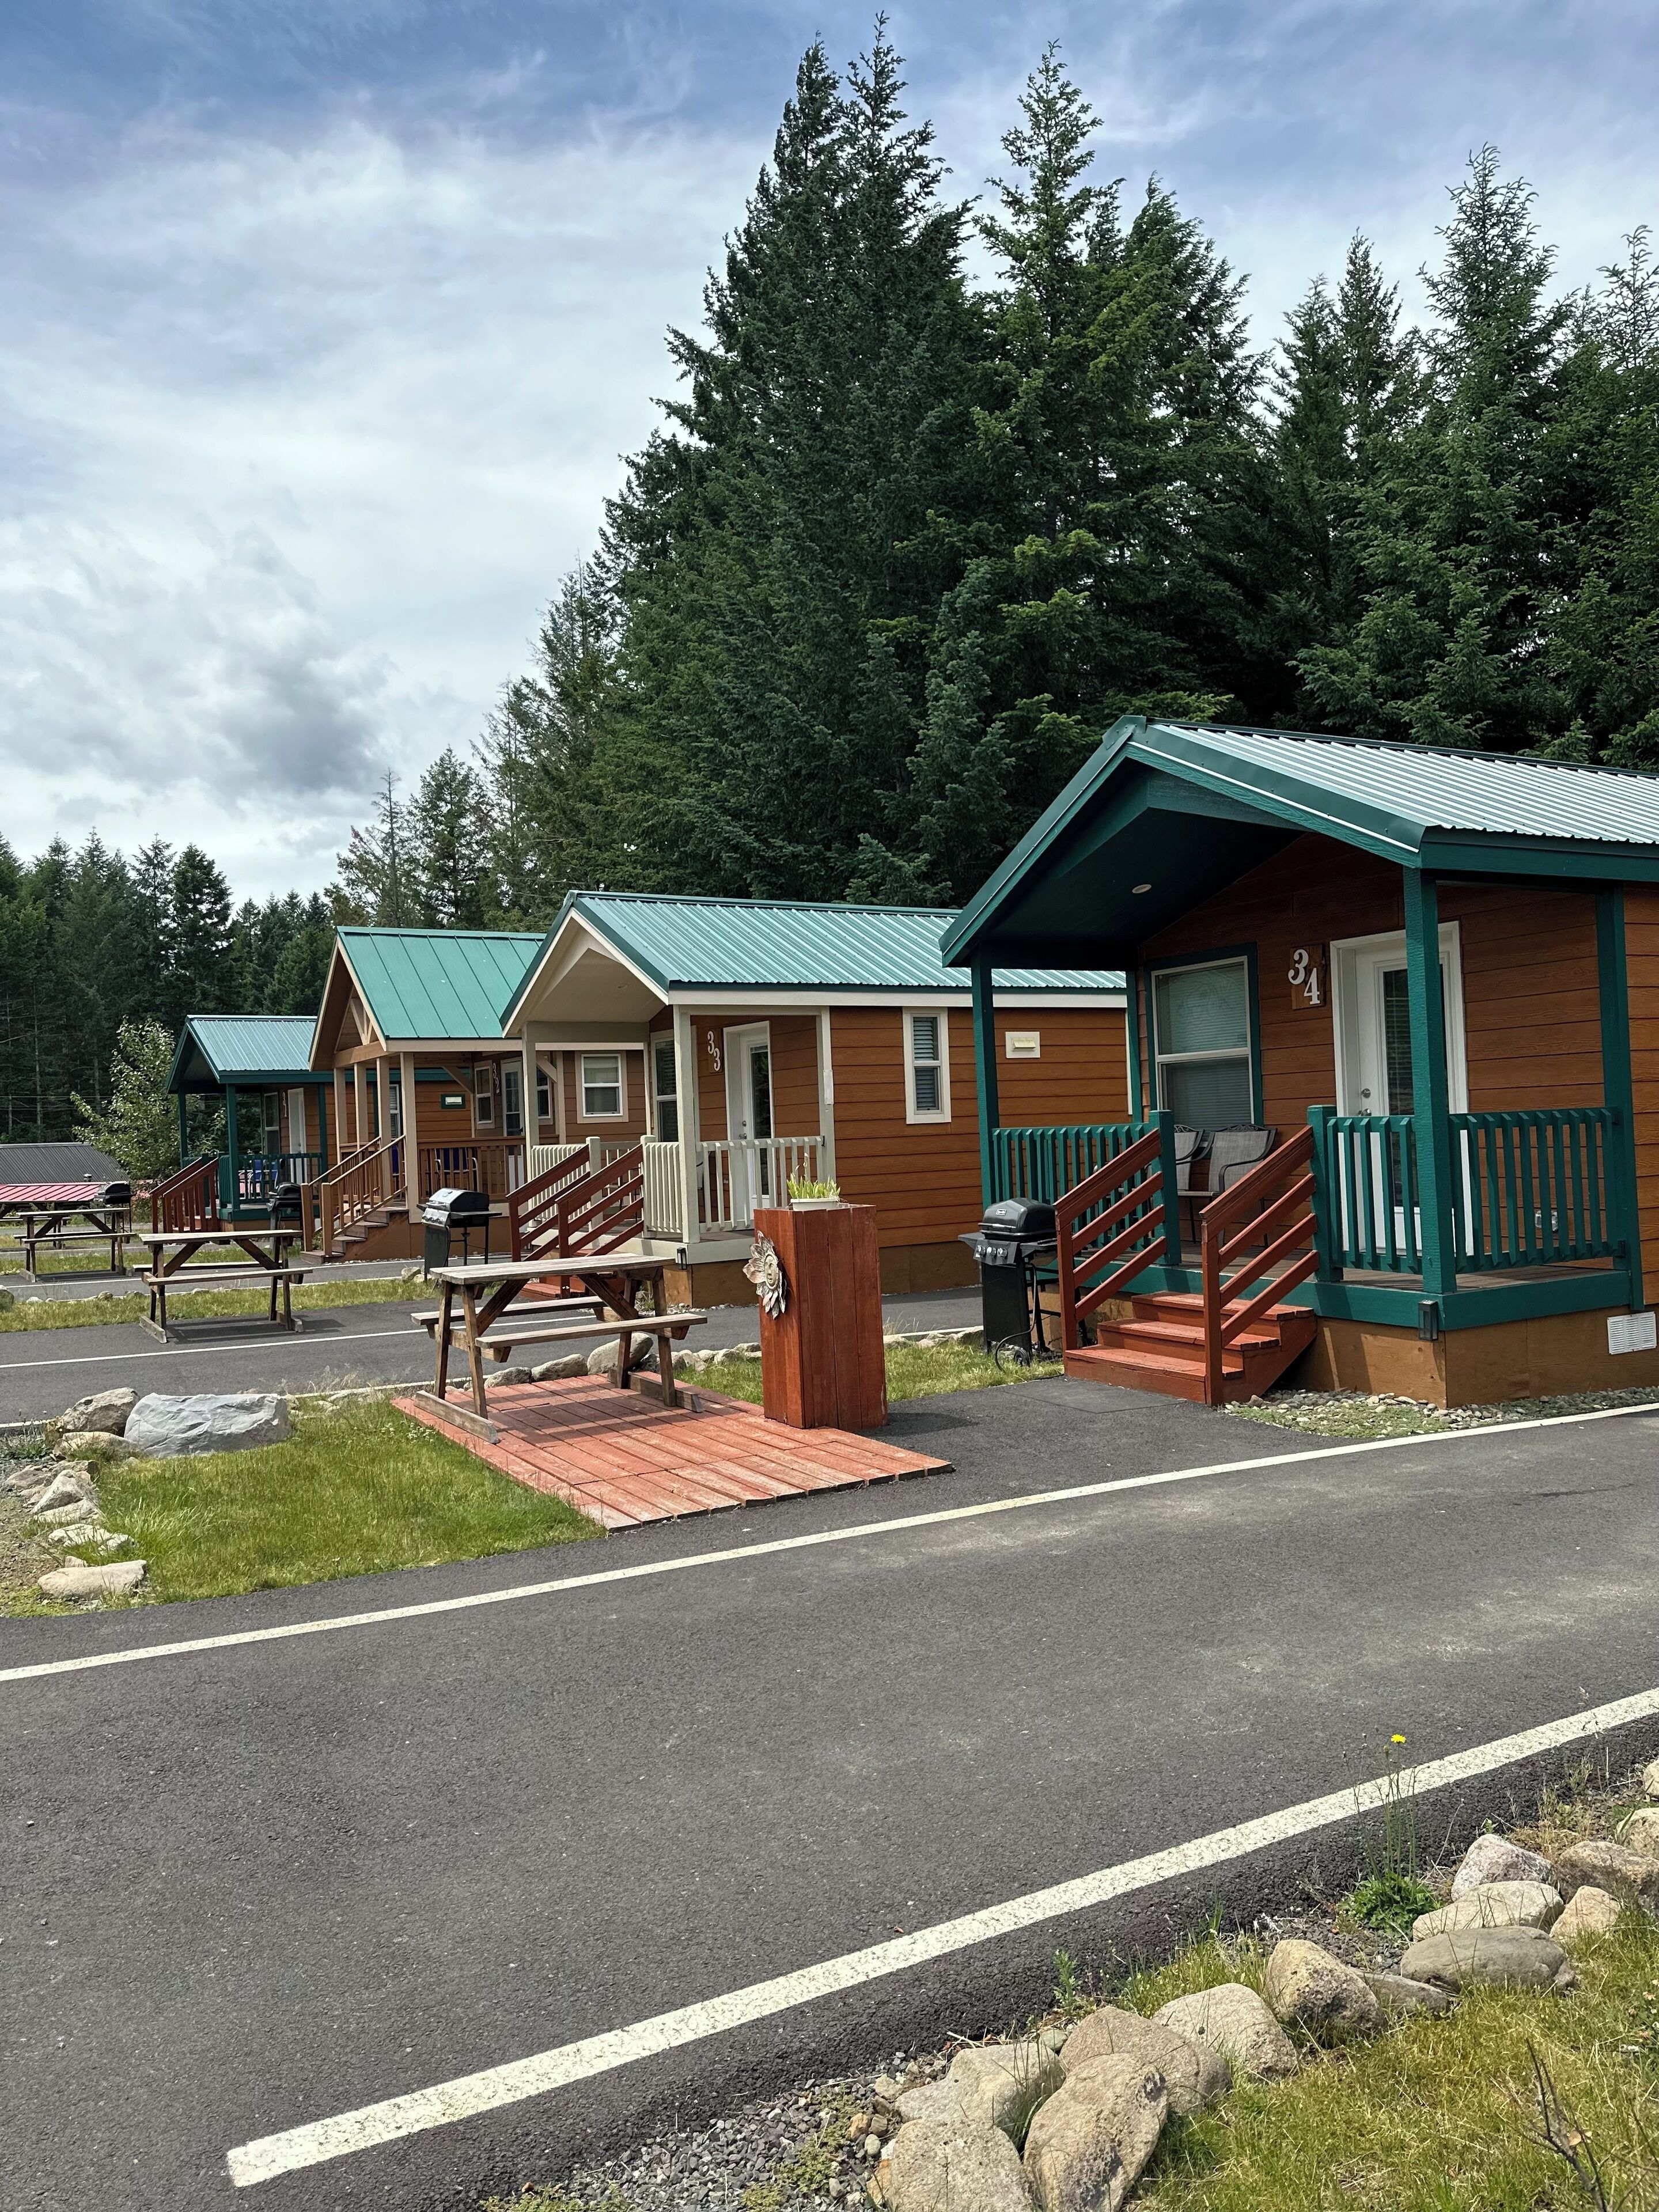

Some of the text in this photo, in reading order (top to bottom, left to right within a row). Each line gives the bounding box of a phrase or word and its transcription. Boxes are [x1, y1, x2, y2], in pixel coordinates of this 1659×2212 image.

[1288, 949, 1320, 1005] 34
[707, 1031, 721, 1071] 33
[493, 1062, 500, 1093] 32
